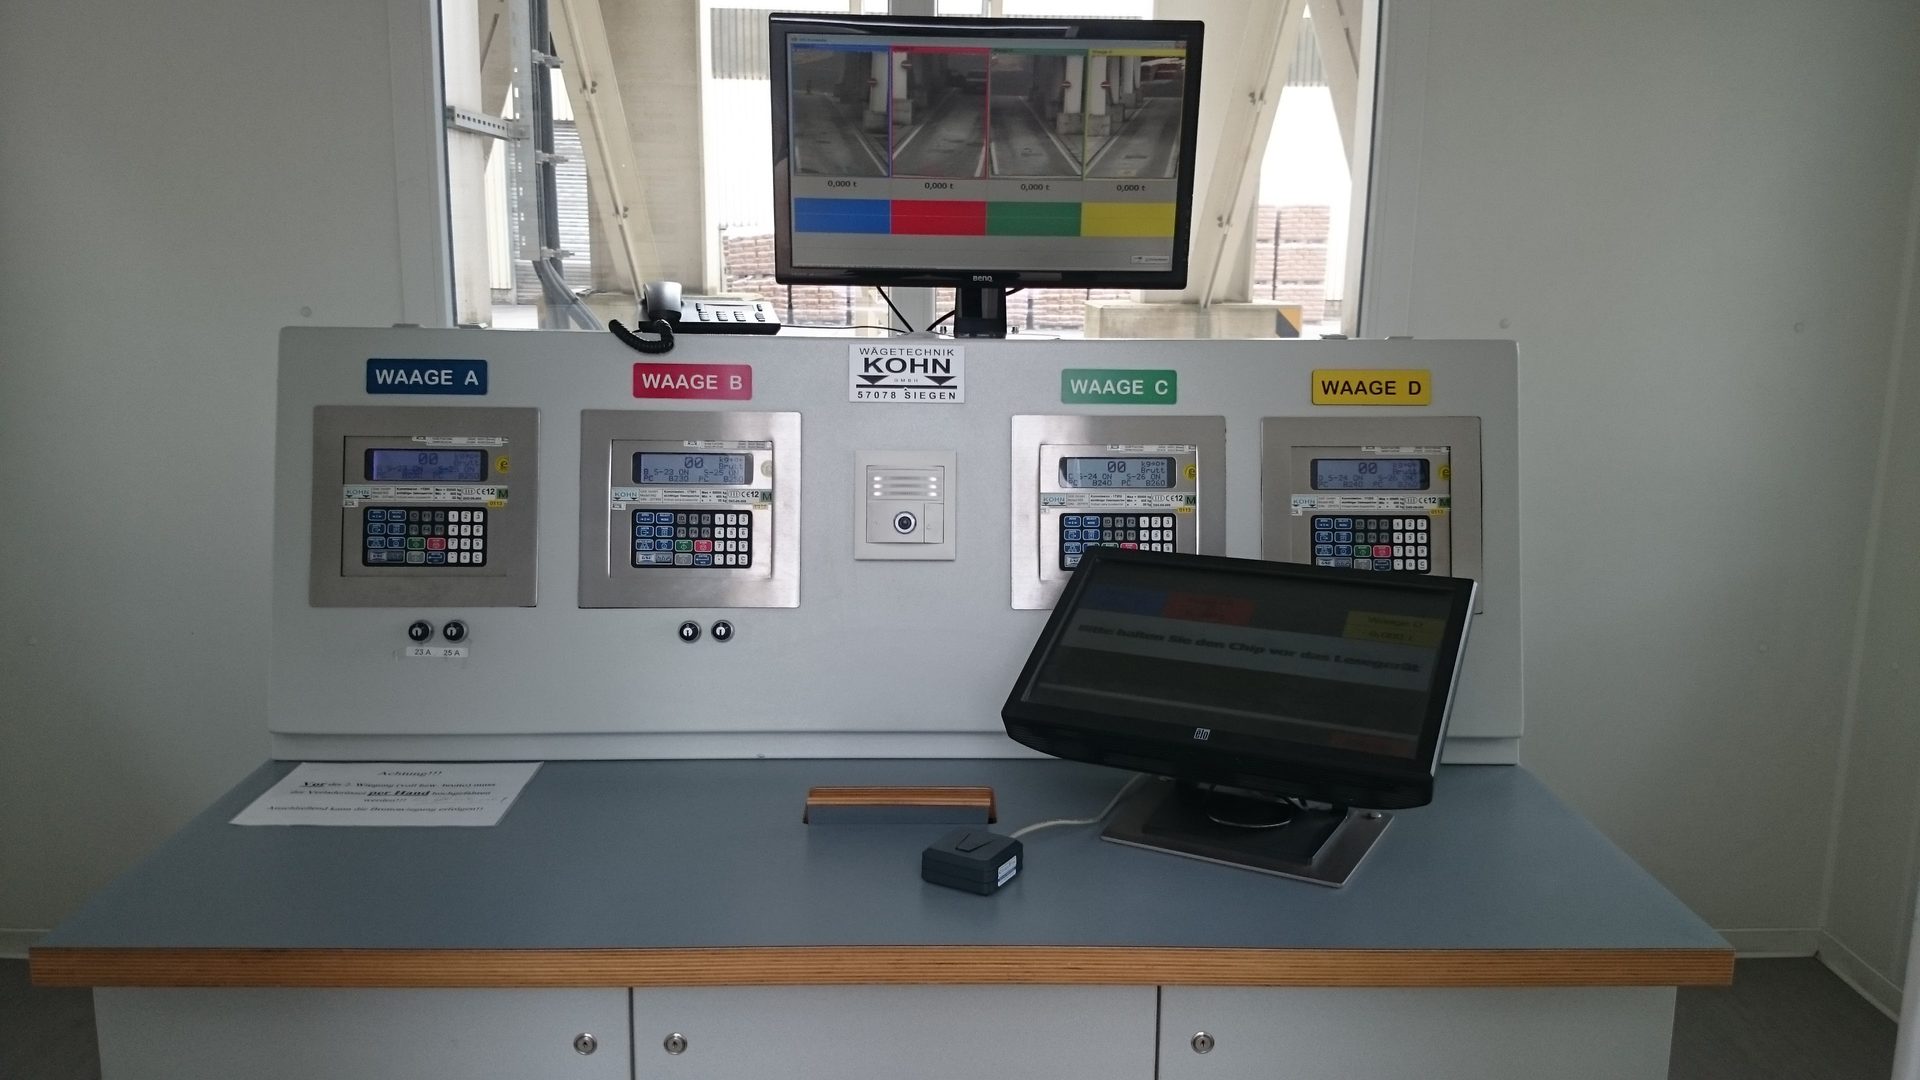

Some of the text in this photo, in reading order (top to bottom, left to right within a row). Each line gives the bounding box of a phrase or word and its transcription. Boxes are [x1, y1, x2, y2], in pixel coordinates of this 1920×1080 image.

[860, 347, 954, 356] WÄGETECHNIK
[864, 357, 950, 374] KOHN
[376, 369, 479, 386] WAAGE A
[642, 374, 742, 390] WAAGE B
[1070, 379, 1168, 395] WAAGE C
[1322, 380, 1421, 395] WAAGE D
[904, 392, 956, 400] SIEGEN
[684, 457, 704, 468] 00
[1107, 461, 1126, 472] 00
[1358, 462, 1377, 474] 00
[1116, 628, 1165, 641] halten
[1168, 635, 1192, 644] Sie
[1195, 638, 1225, 649] den
[1229, 642, 1266, 654] Chip
[1269, 648, 1296, 656] vor
[1300, 651, 1330, 662] das
